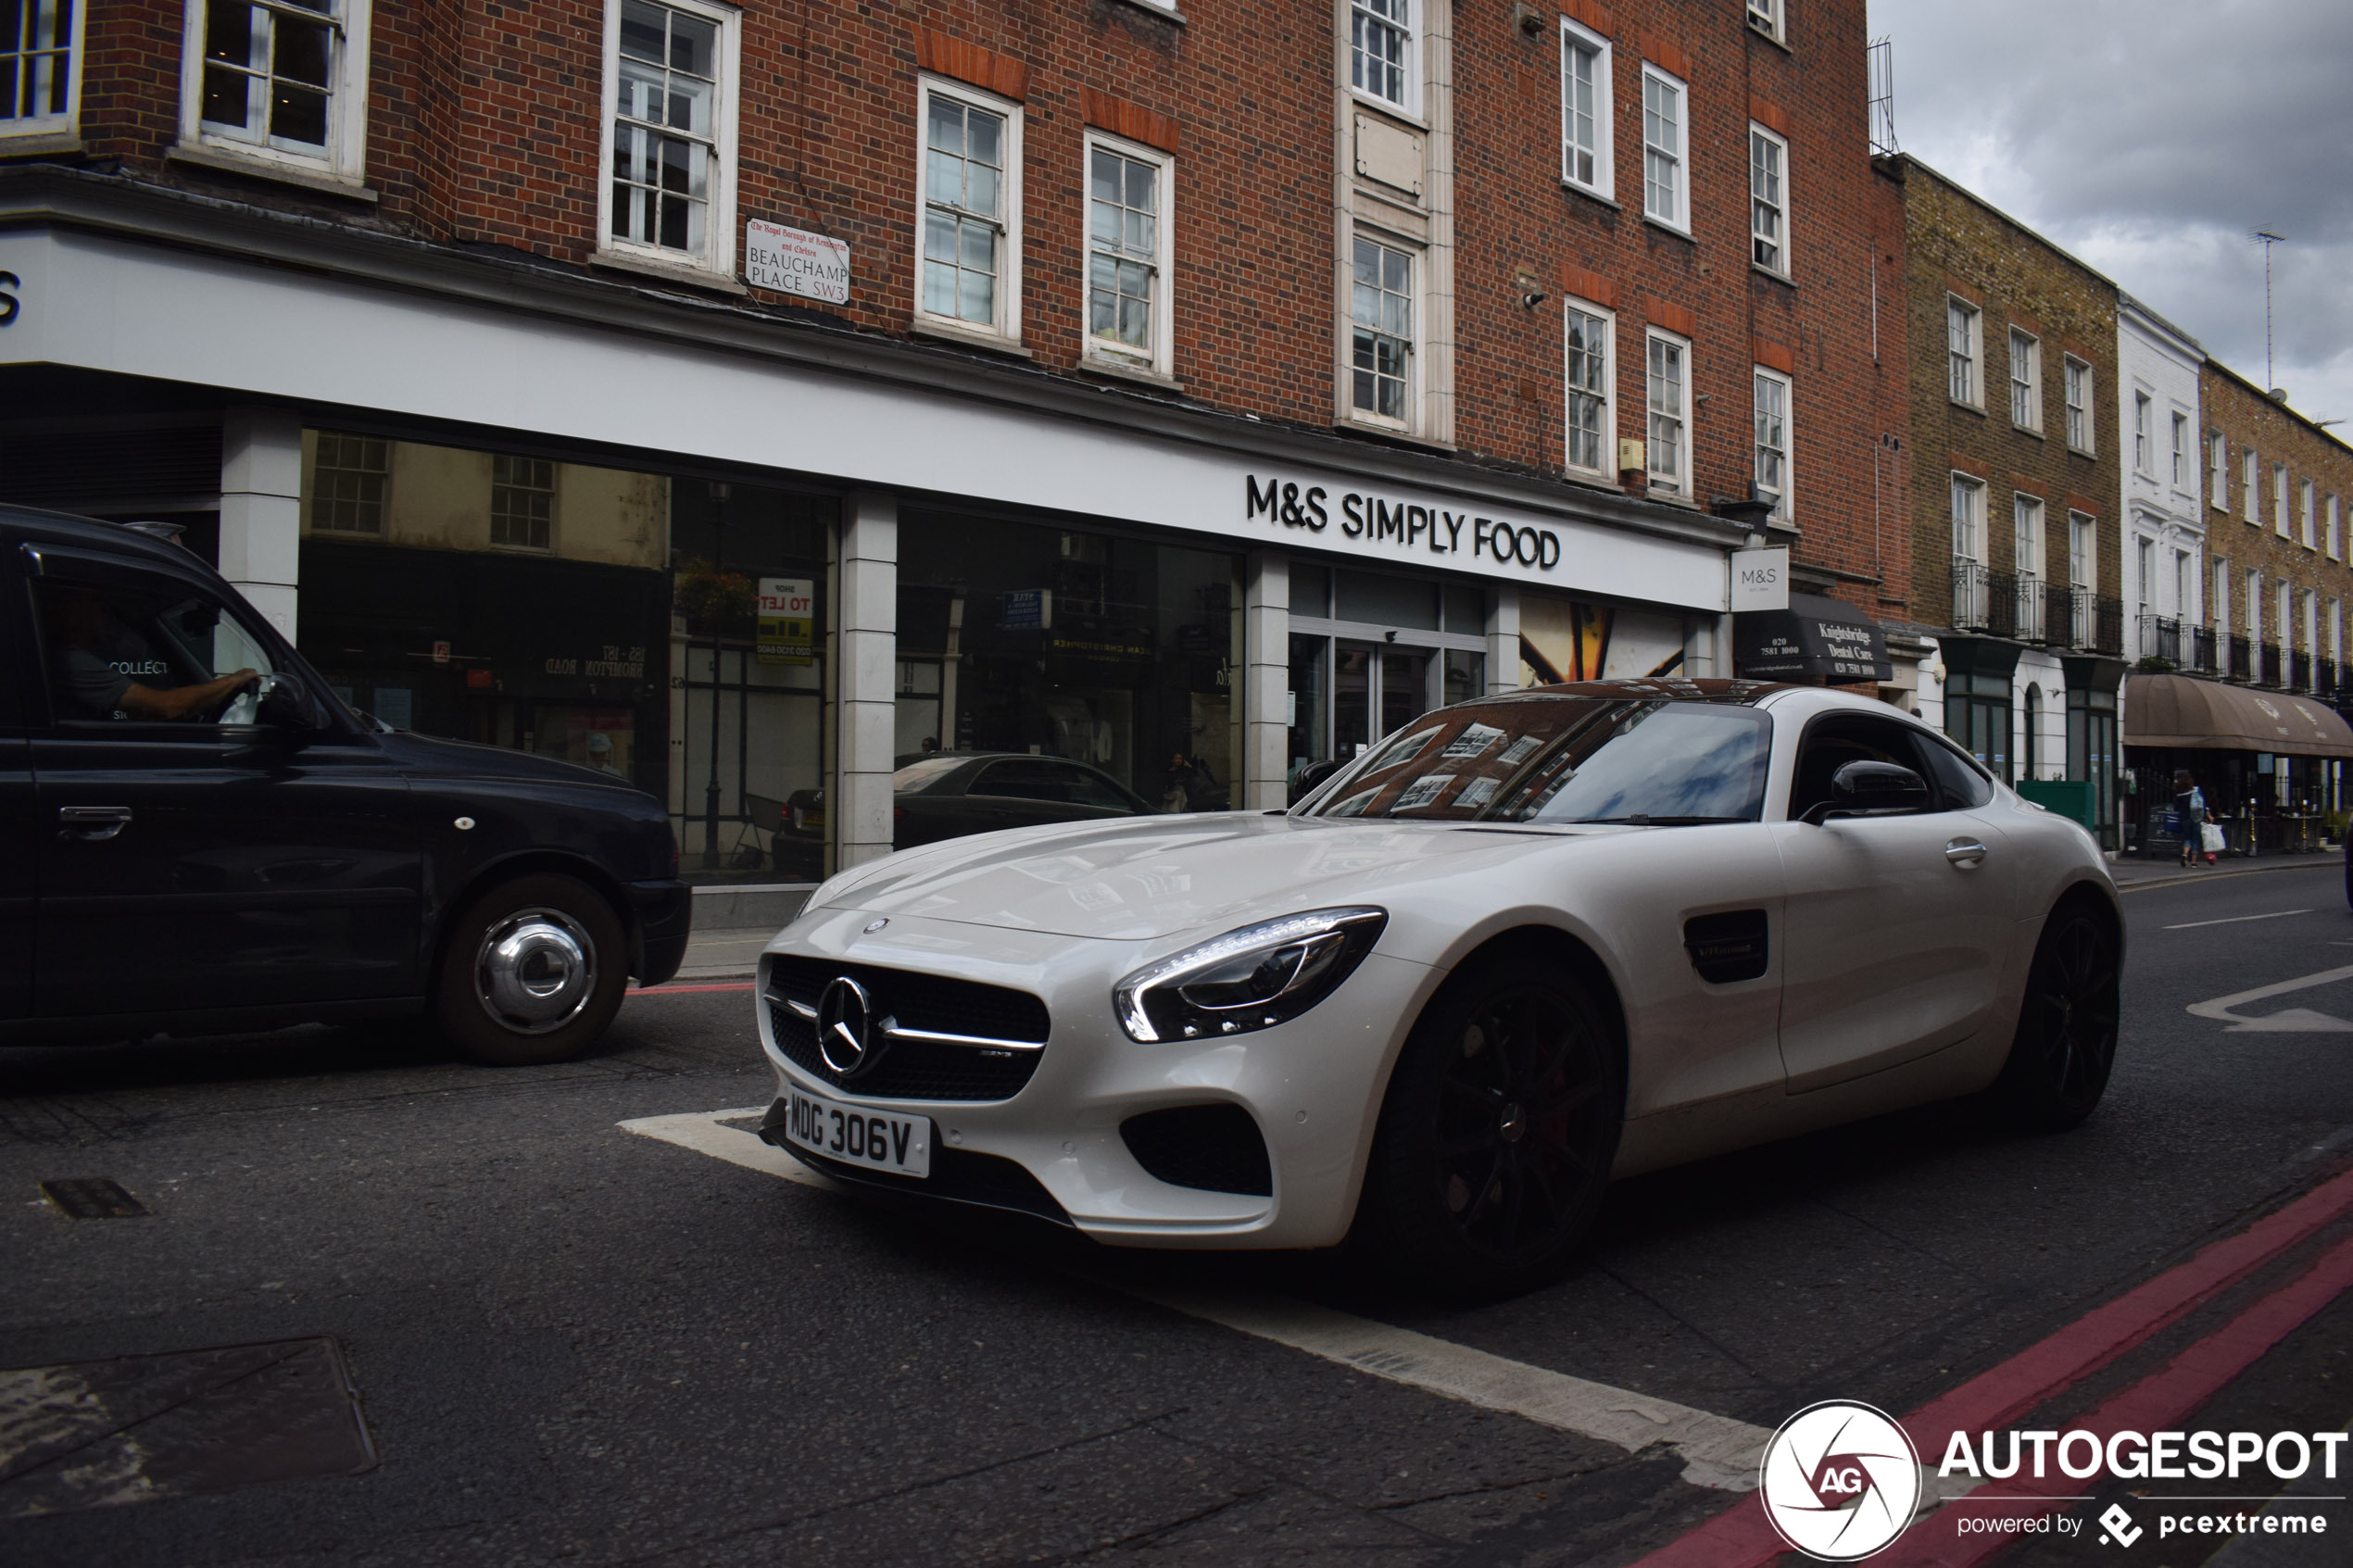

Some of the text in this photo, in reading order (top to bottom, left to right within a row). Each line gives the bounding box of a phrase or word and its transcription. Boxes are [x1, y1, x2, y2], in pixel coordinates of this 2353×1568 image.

[750, 220, 762, 231] The
[763, 223, 781, 237] Royal
[783, 229, 807, 244] Borough
[782, 243, 816, 257] and Chelsea
[750, 247, 849, 283] BEAUCHAMP
[1246, 473, 1561, 570] M&S SIMPLY FOOD
[1742, 568, 1777, 584] M&S
[1772, 637, 1787, 646] 020
[1818, 622, 1871, 646] Knightsbridge
[1760, 646, 1799, 656] 7581 1000
[1827, 643, 1874, 660] Dental Care
[791, 1093, 912, 1165] MDG 306V
